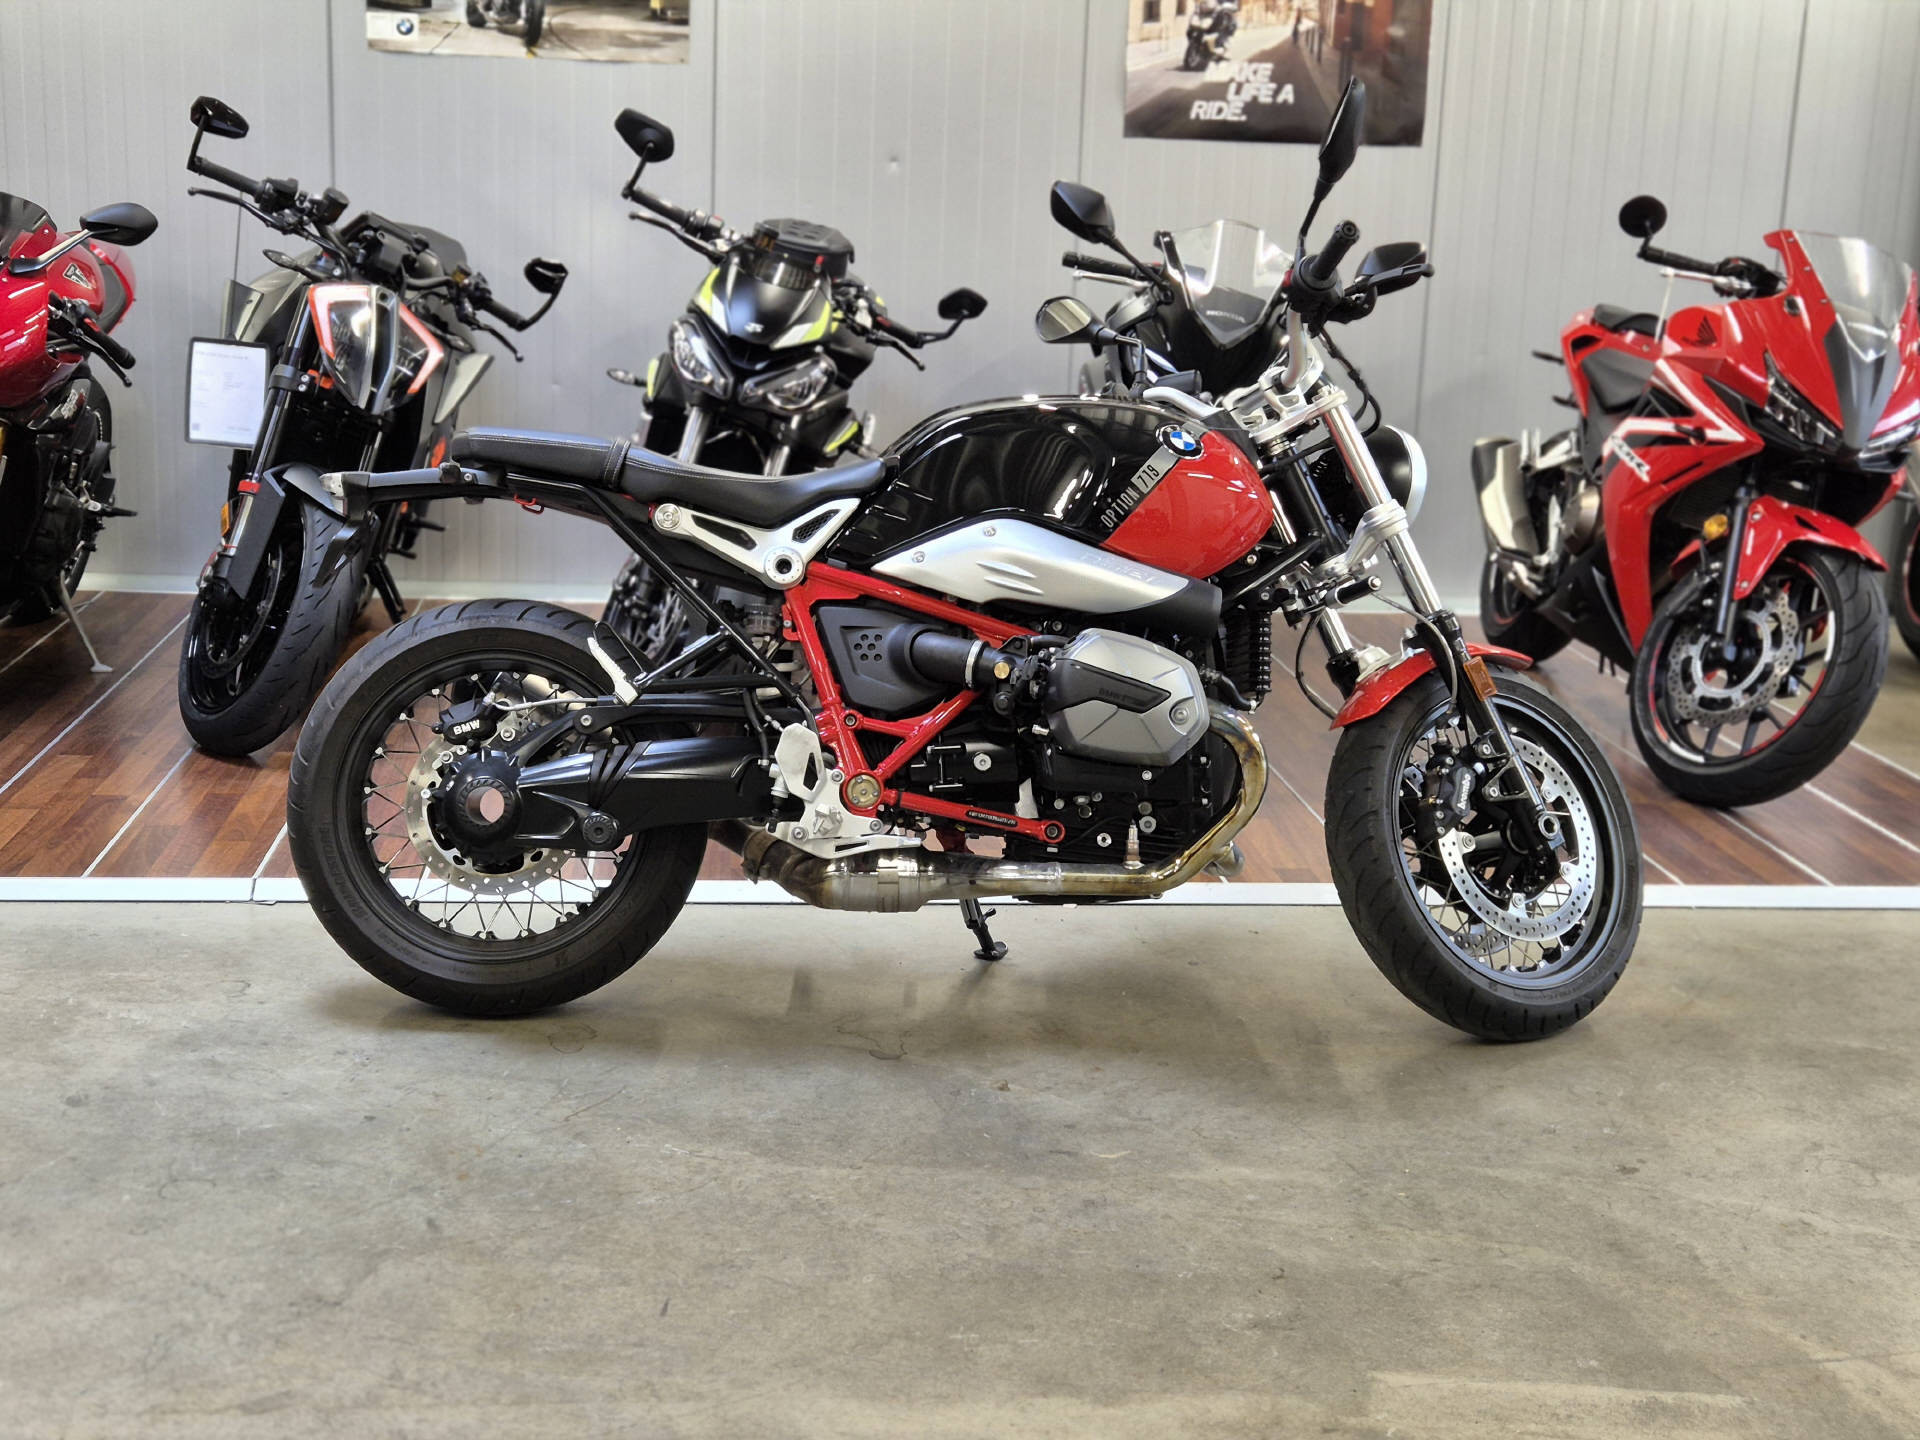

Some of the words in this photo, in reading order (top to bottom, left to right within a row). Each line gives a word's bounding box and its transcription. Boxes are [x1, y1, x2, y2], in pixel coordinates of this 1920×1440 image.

[1226, 81, 1277, 104] LIFE
[1276, 83, 1295, 104] A
[1189, 100, 1247, 121] RIDE.
[1100, 486, 1140, 528] OPTION
[1137, 464, 1160, 488] 719
[453, 719, 480, 735] BMW
[1457, 773, 1471, 810] brembo
